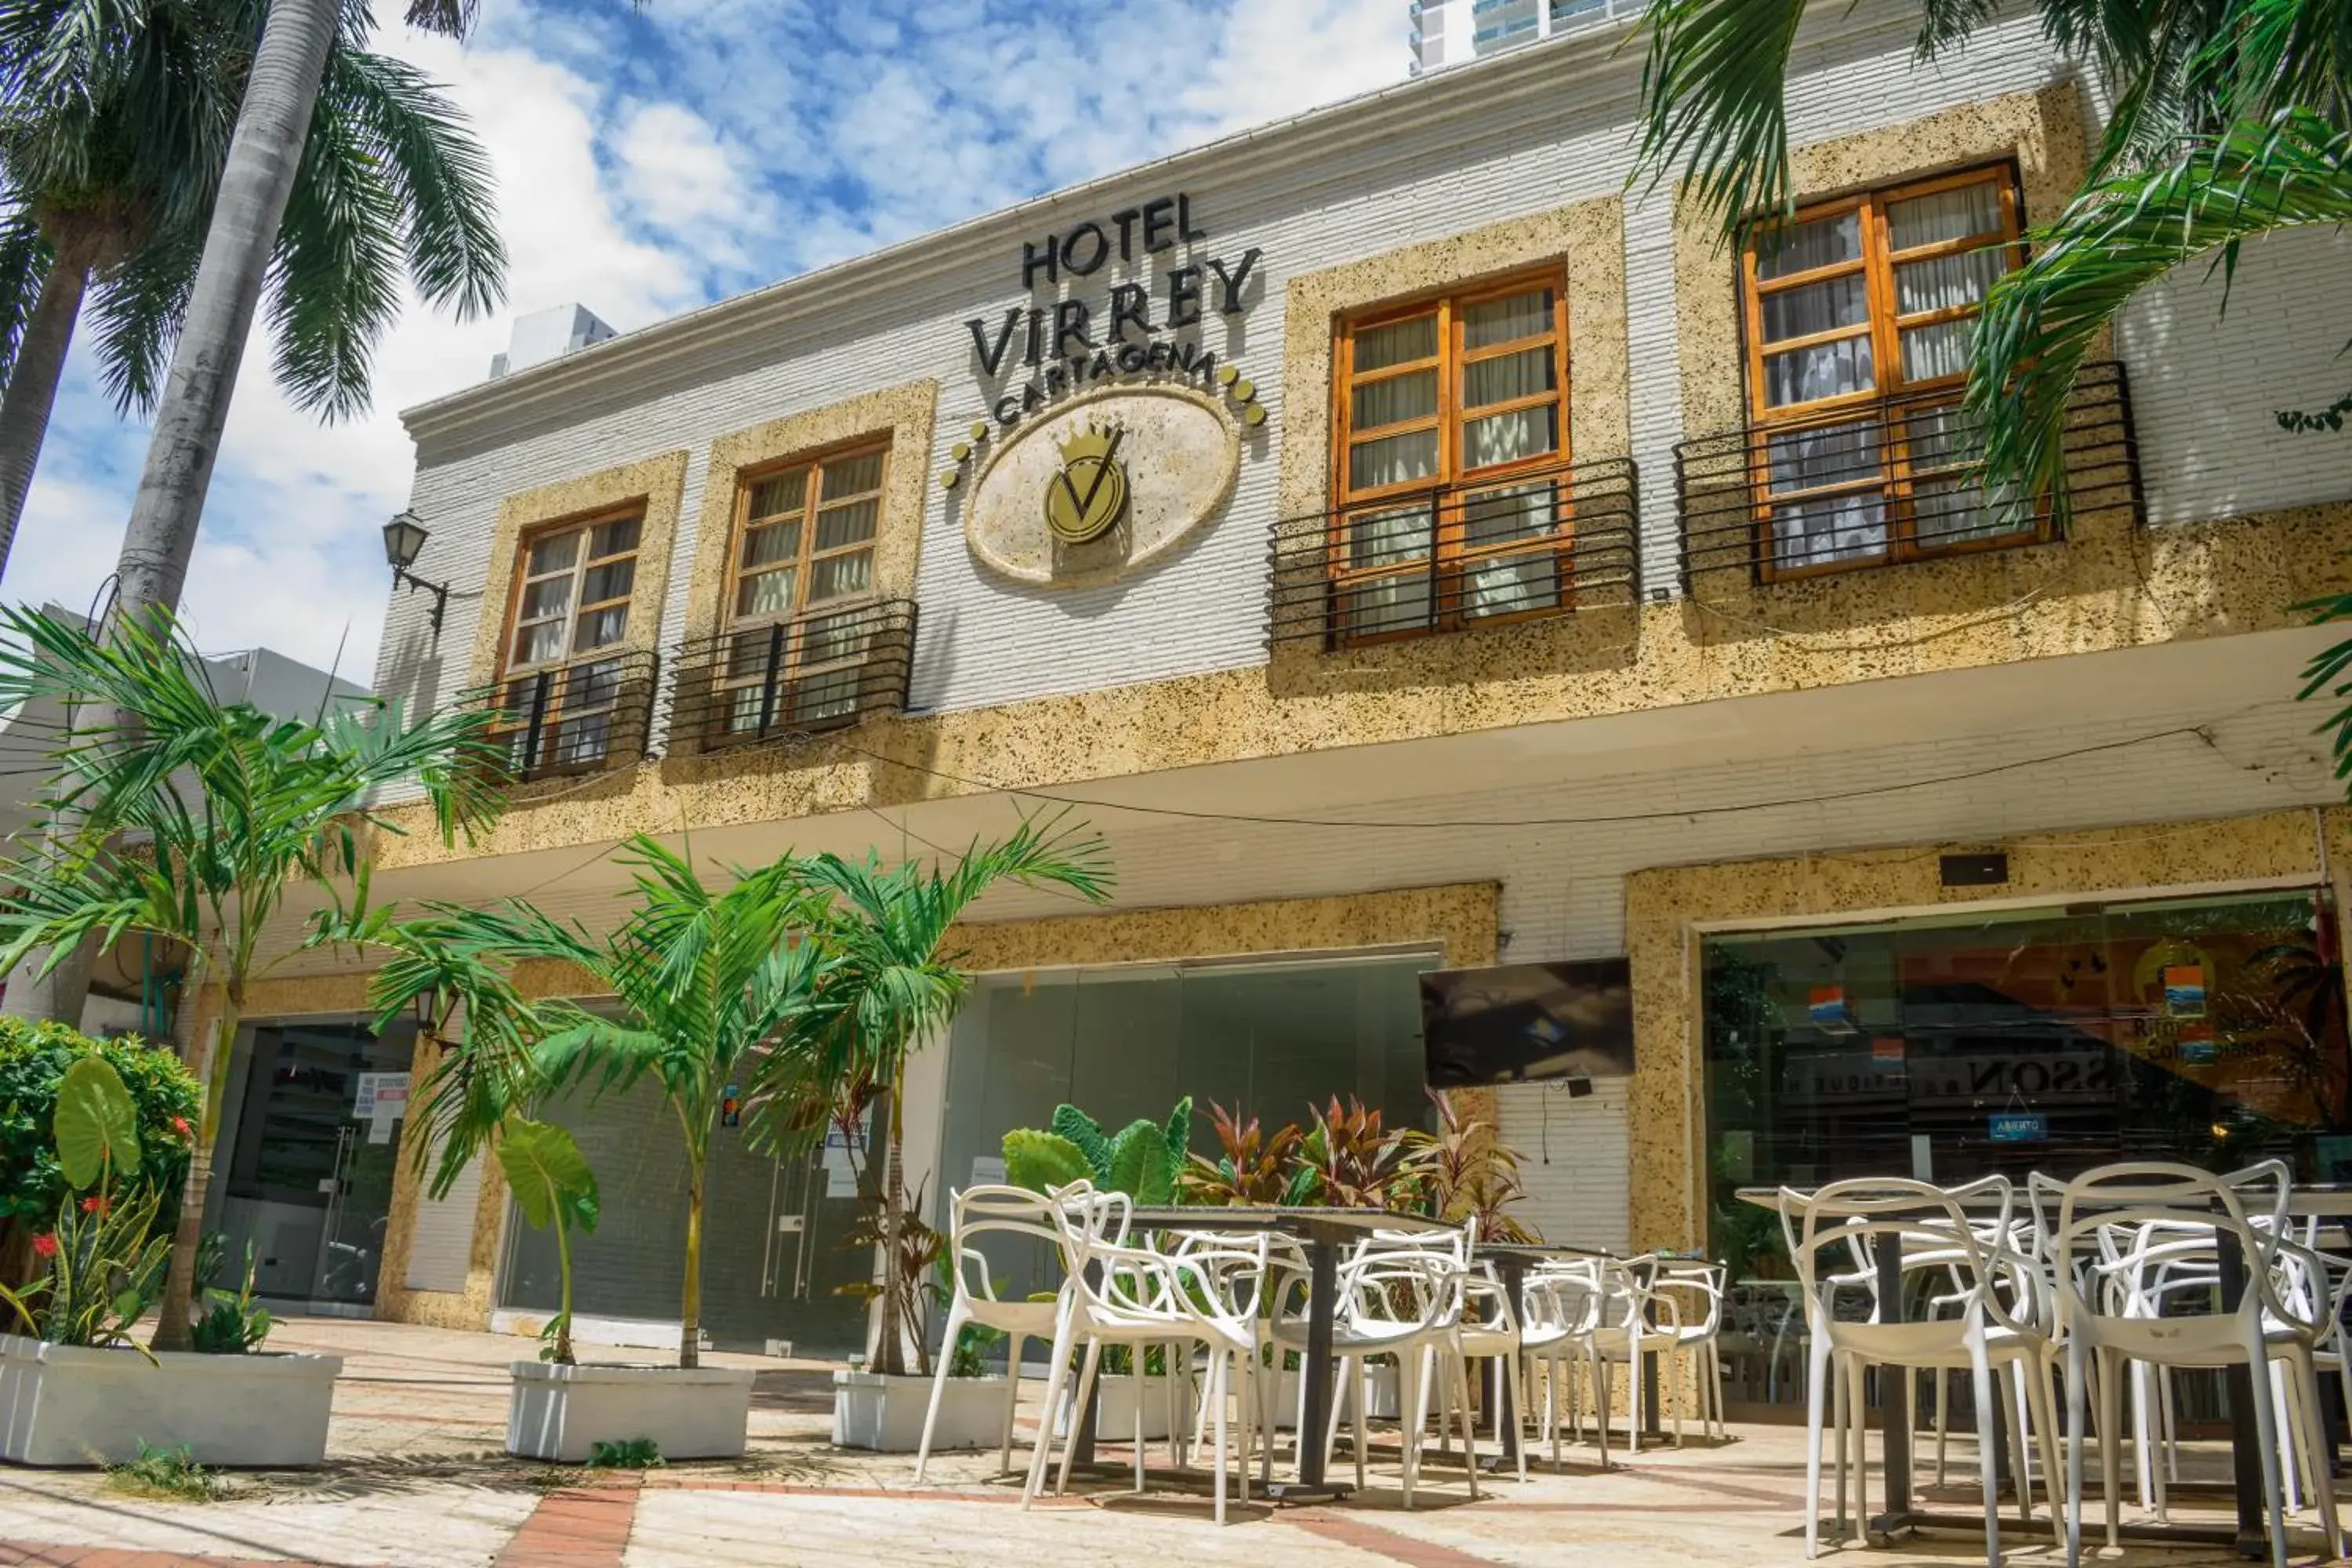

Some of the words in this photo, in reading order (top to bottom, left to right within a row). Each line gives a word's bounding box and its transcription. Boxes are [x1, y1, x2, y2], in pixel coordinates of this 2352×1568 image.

[1022, 192, 1208, 290] HOTEL
[964, 247, 1265, 377] VIRREY
[993, 341, 1217, 426] CARTAGENA
[1057, 425, 1124, 523] V
